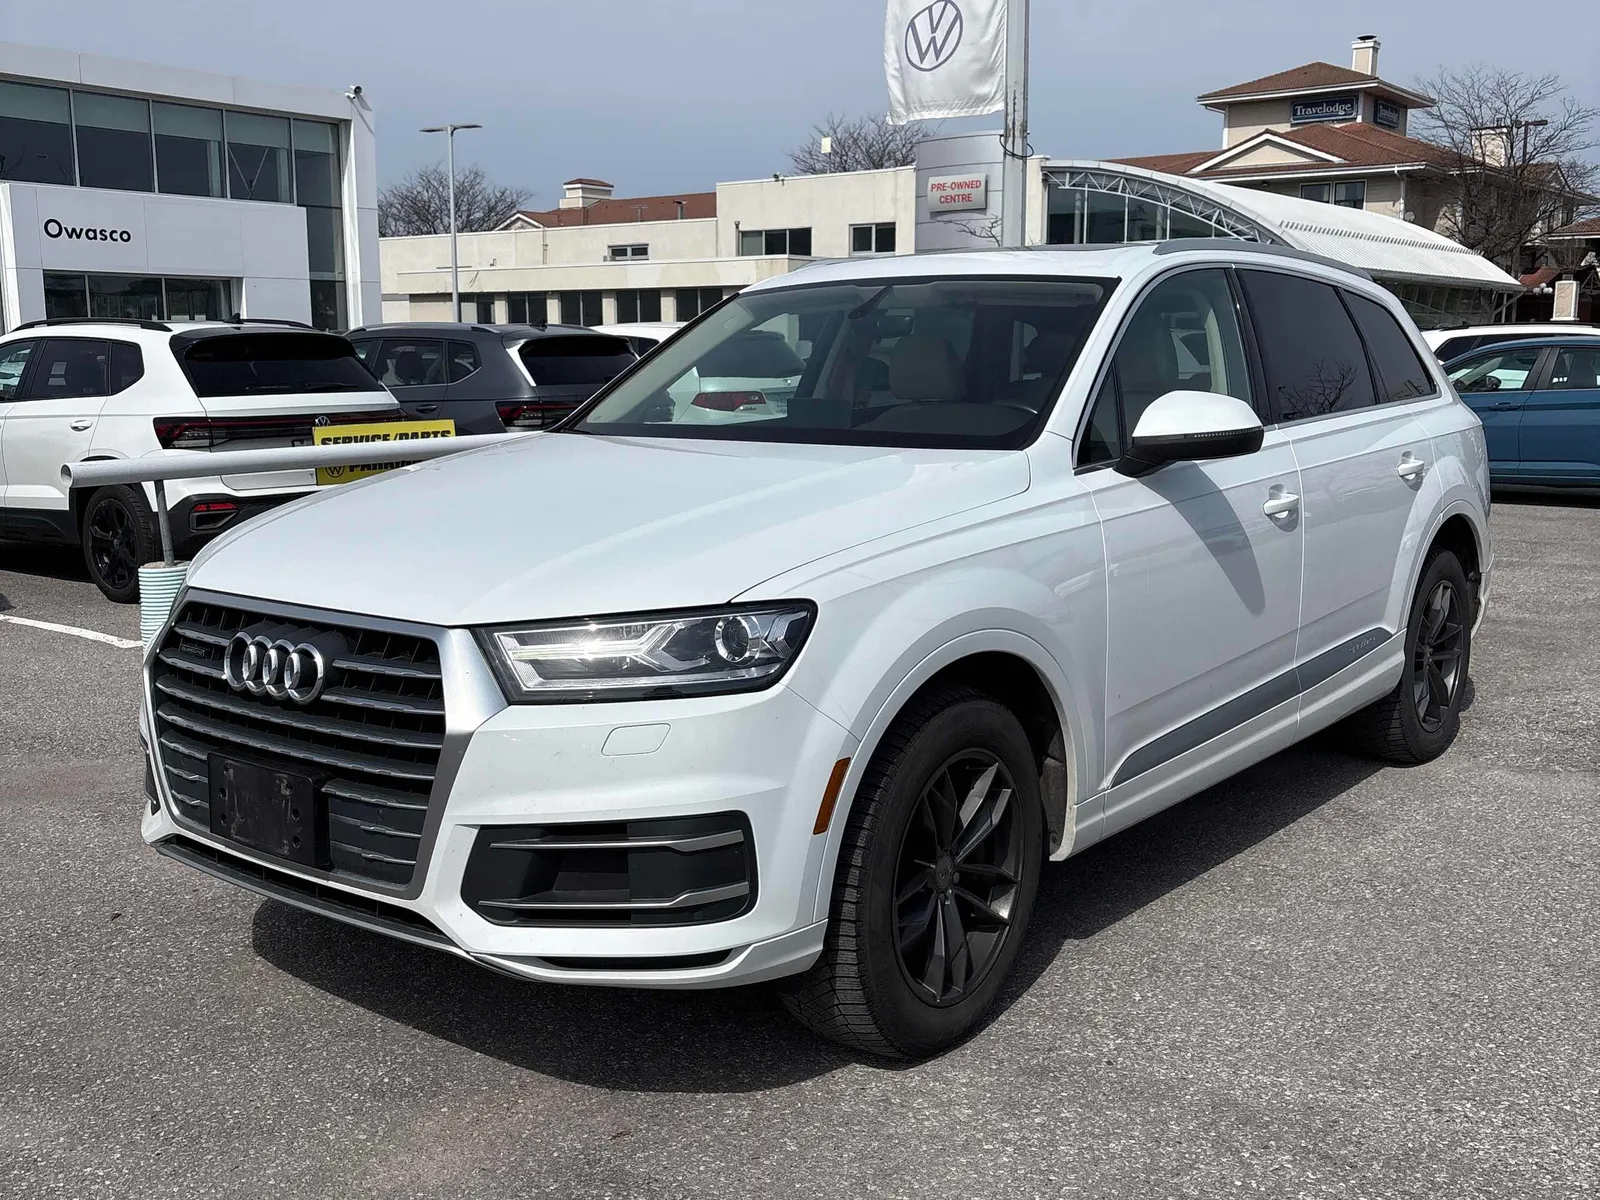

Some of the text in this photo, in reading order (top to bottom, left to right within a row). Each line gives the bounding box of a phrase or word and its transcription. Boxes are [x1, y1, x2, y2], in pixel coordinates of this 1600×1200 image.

[1294, 102, 1352, 115] Travelodge
[930, 180, 982, 192] PRE-OWNED
[939, 193, 973, 204] CENTRE
[43, 218, 132, 243] Owasco
